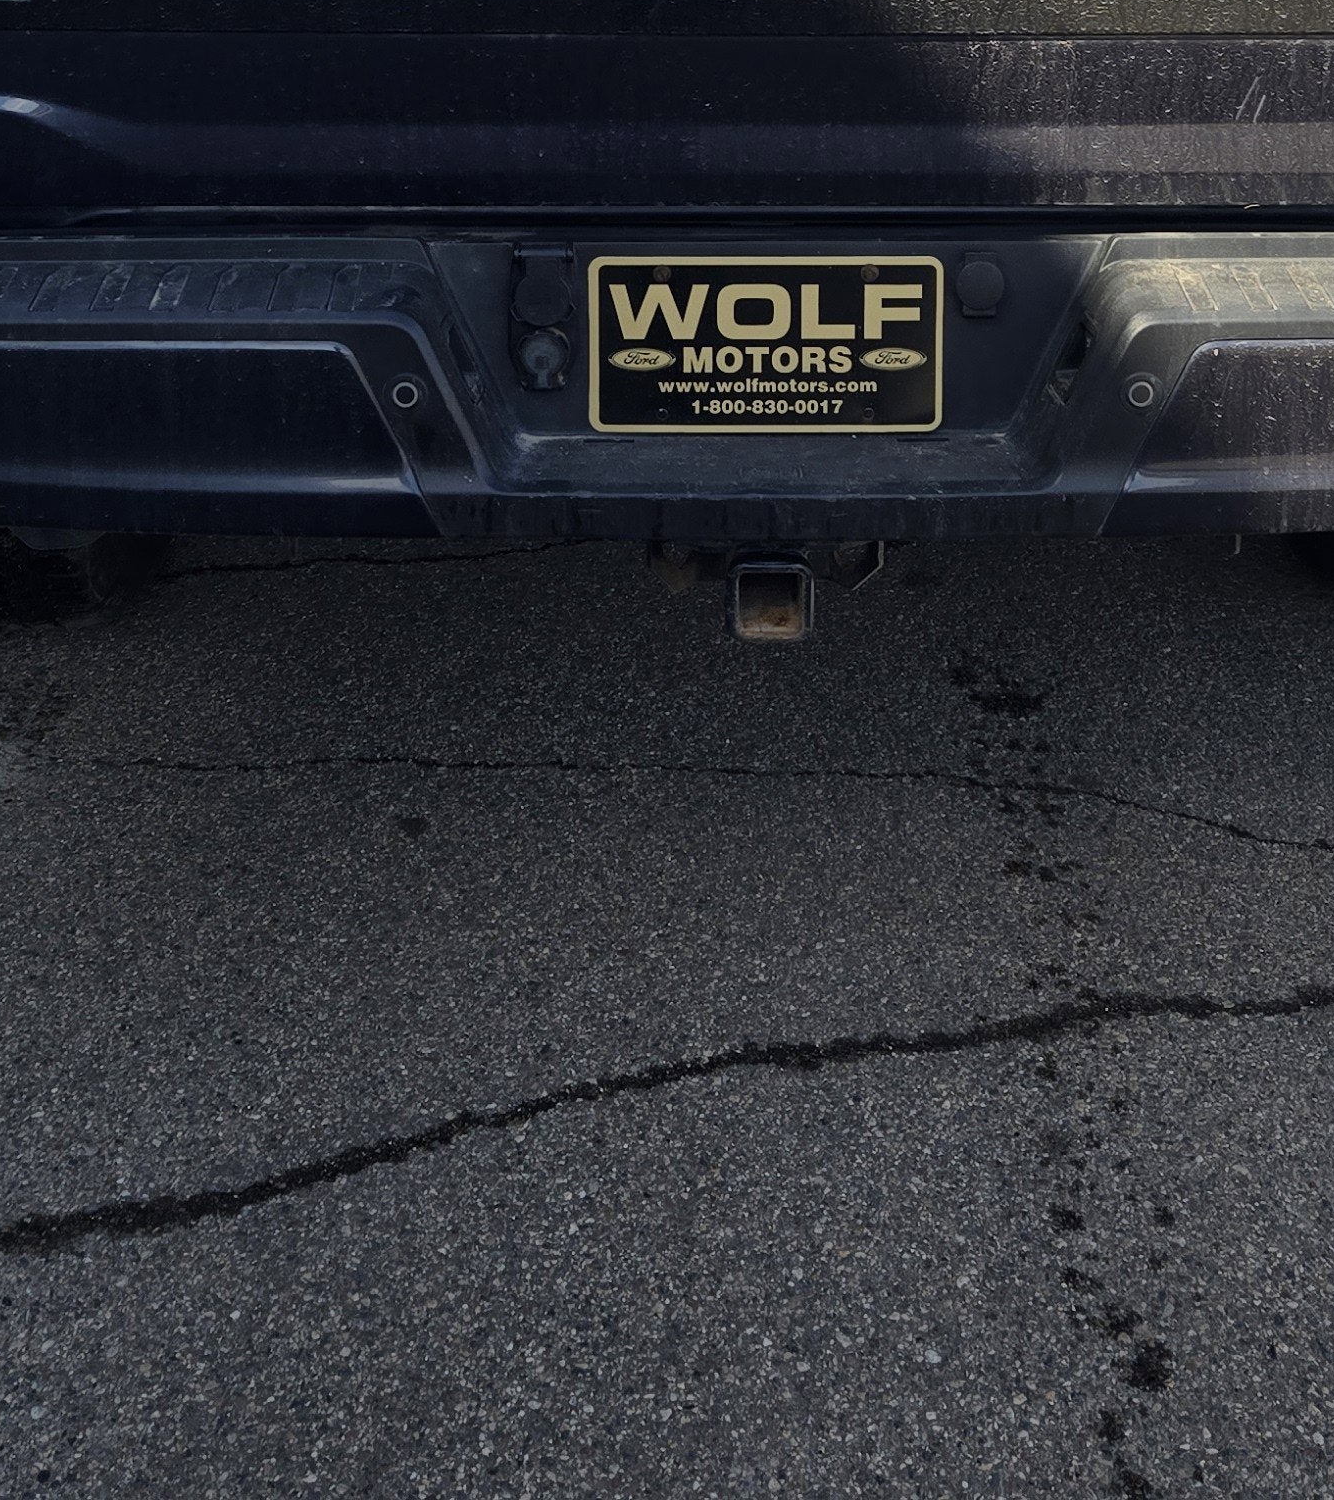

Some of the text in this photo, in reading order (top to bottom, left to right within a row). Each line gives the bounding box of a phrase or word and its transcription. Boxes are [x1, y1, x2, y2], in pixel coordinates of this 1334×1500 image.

[608, 283, 923, 340] WOLF
[622, 351, 660, 367] Ford
[682, 346, 853, 374] MOTORS
[873, 351, 911, 367] Ford
[657, 378, 878, 393] www.wolfmotors.com
[691, 399, 844, 415] 1-800-830-0017
